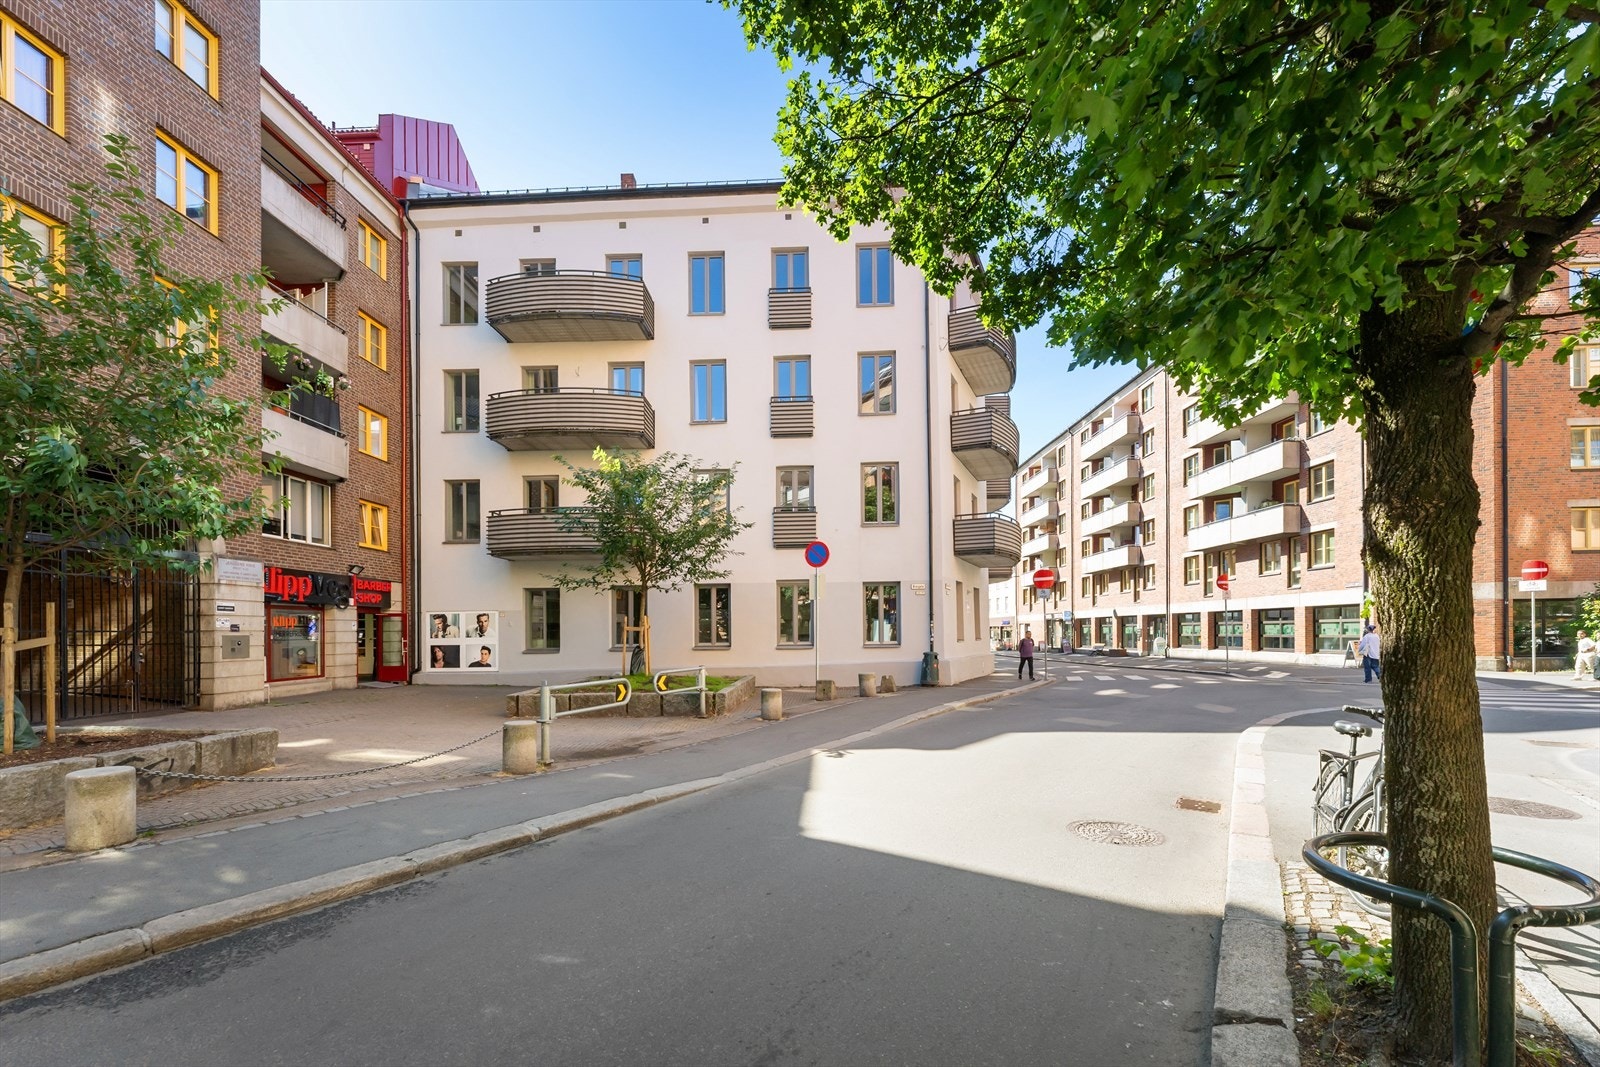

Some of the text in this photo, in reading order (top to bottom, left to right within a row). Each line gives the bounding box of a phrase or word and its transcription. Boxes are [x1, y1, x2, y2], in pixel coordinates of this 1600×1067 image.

[264, 567, 312, 602] lipp
[357, 579, 391, 592] BARBER
[357, 593, 383, 604] SHOP
